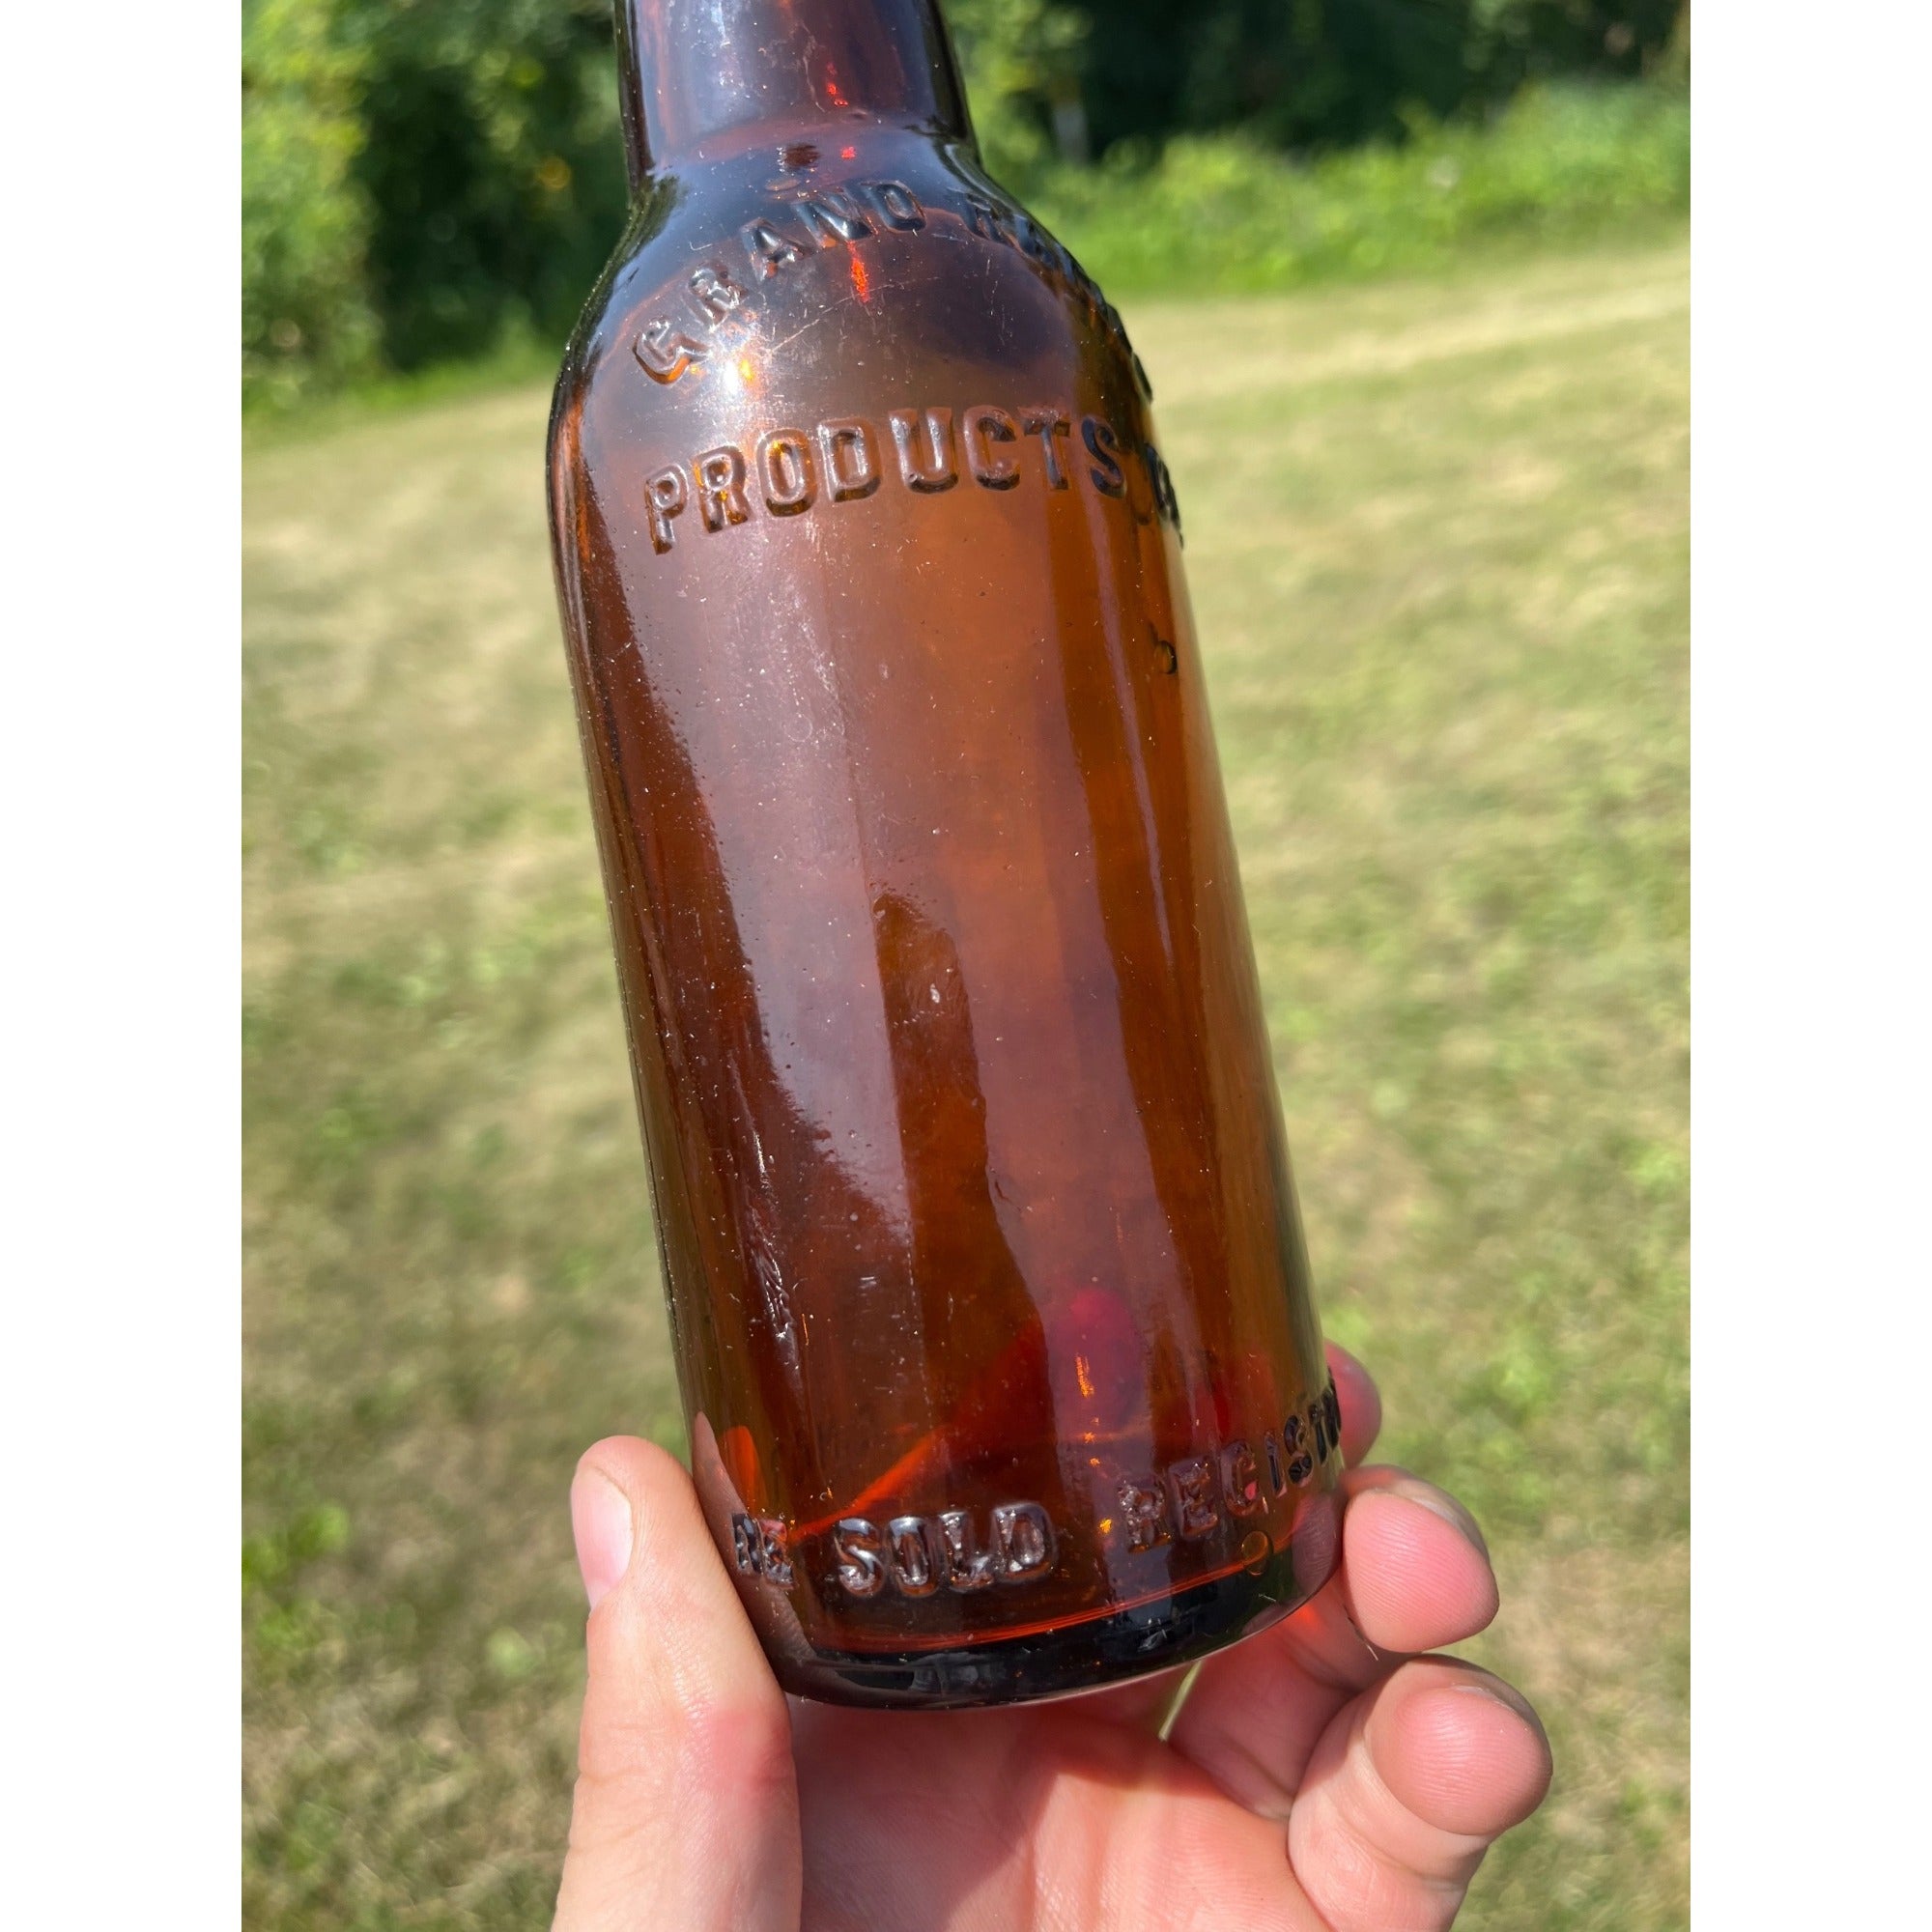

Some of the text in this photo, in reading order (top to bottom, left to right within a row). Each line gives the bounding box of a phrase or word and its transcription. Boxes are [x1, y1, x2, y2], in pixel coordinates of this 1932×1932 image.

[633, 180, 925, 384] GRAND
[644, 406, 1128, 554] PRODUCTS
[833, 1501, 1057, 1596] SOLD
